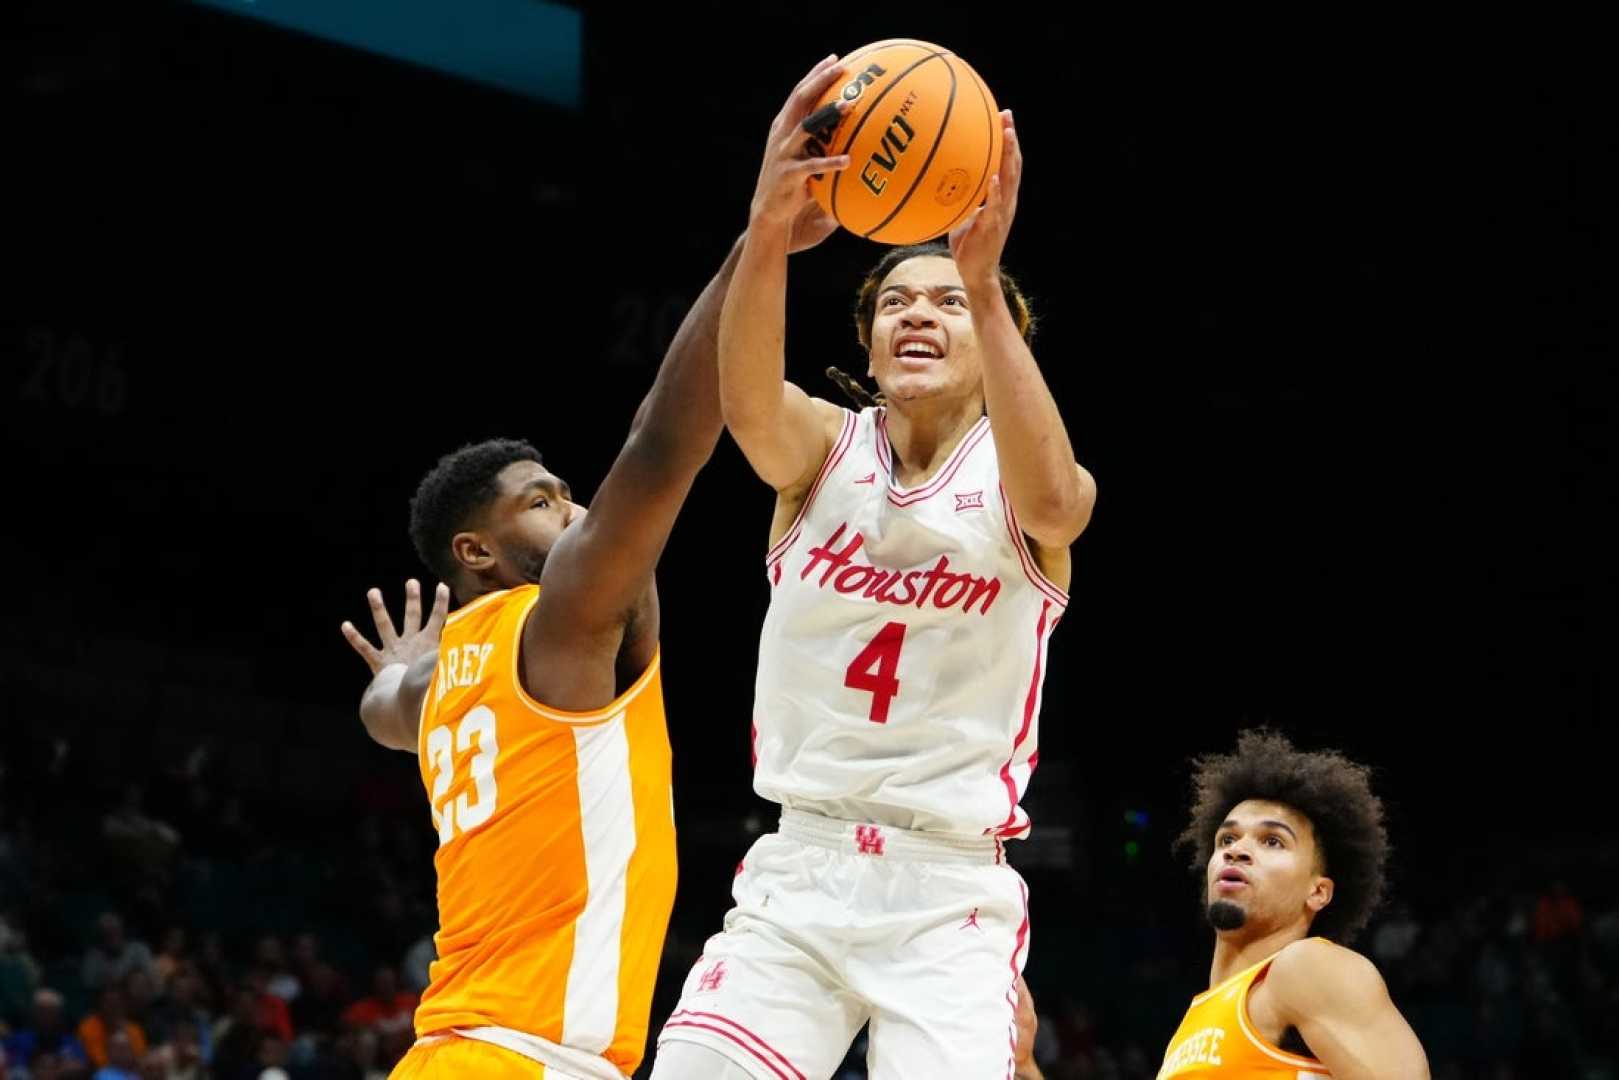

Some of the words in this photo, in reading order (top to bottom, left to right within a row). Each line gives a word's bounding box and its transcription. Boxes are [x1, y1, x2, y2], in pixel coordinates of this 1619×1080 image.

[860, 114, 915, 196] EVO
[20, 326, 128, 415] 206
[800, 521, 1001, 616] Houston
[435, 642, 495, 704] AREY
[843, 620, 907, 725] 4
[427, 703, 500, 847] 23
